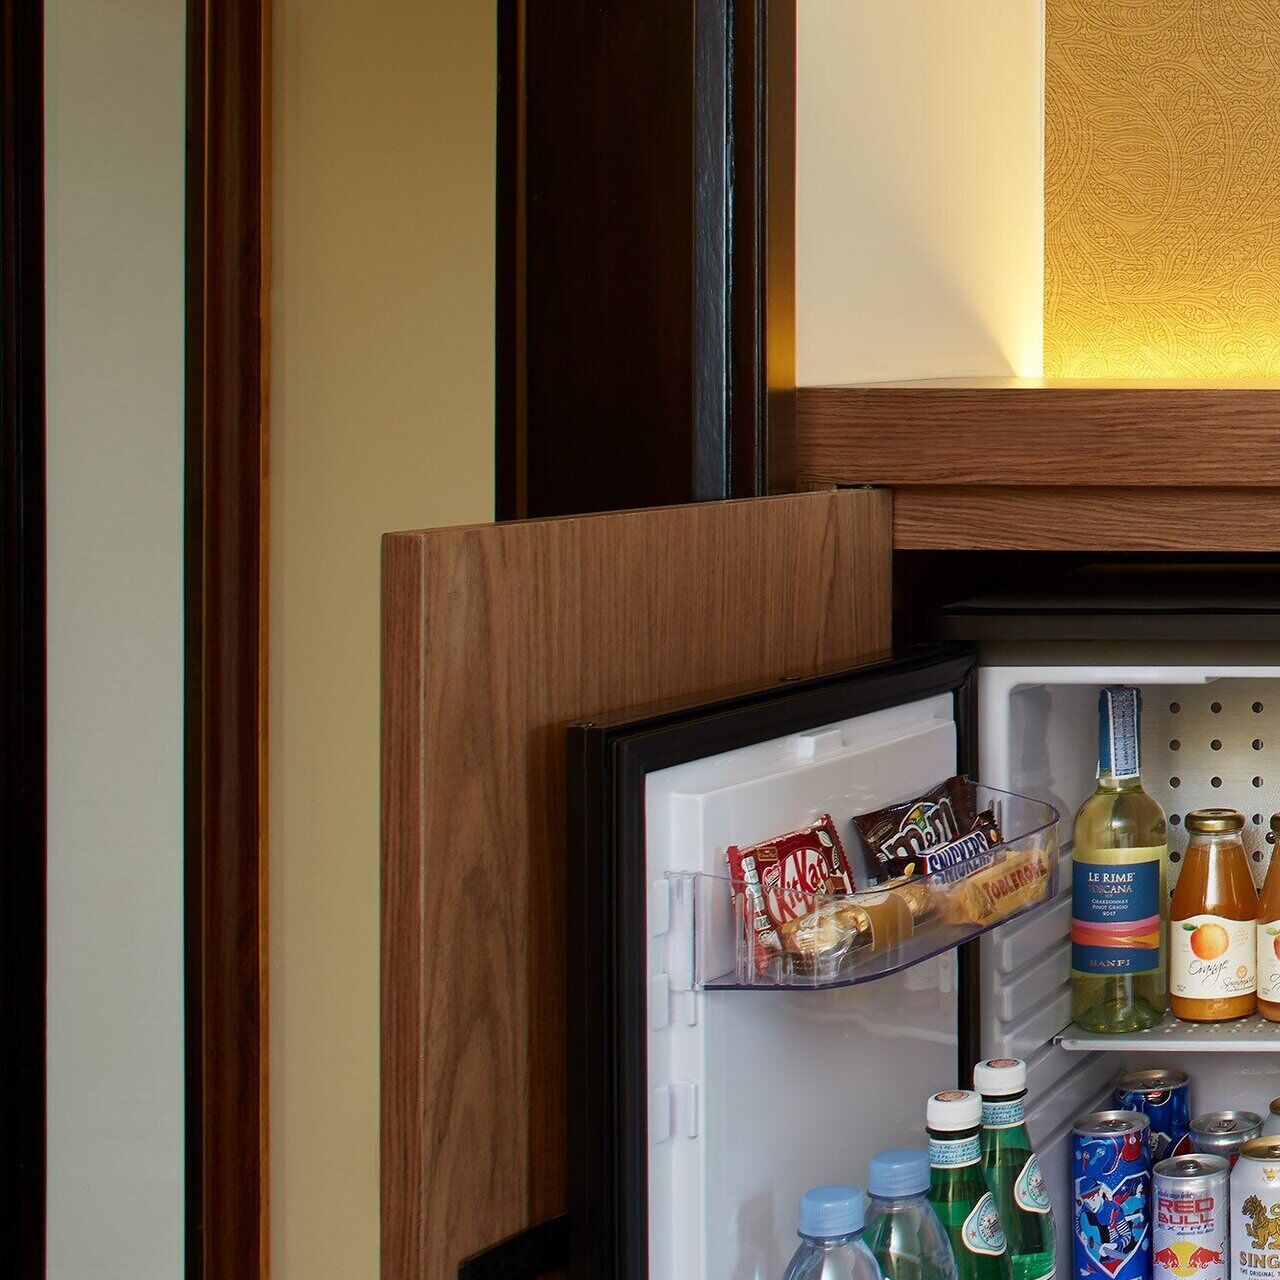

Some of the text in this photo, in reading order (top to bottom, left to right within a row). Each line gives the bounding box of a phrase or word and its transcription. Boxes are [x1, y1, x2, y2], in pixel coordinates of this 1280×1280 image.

[982, 859, 1048, 903] TOBLERONE
[1088, 872, 1134, 882] LE RIME
[1089, 885, 1133, 894] TOSCANA
[1188, 958, 1230, 985] Orange
[1157, 1197, 1214, 1214] RED
[1157, 1211, 1215, 1226] BULL
[1249, 1269, 1275, 1278] ORIGINAL
